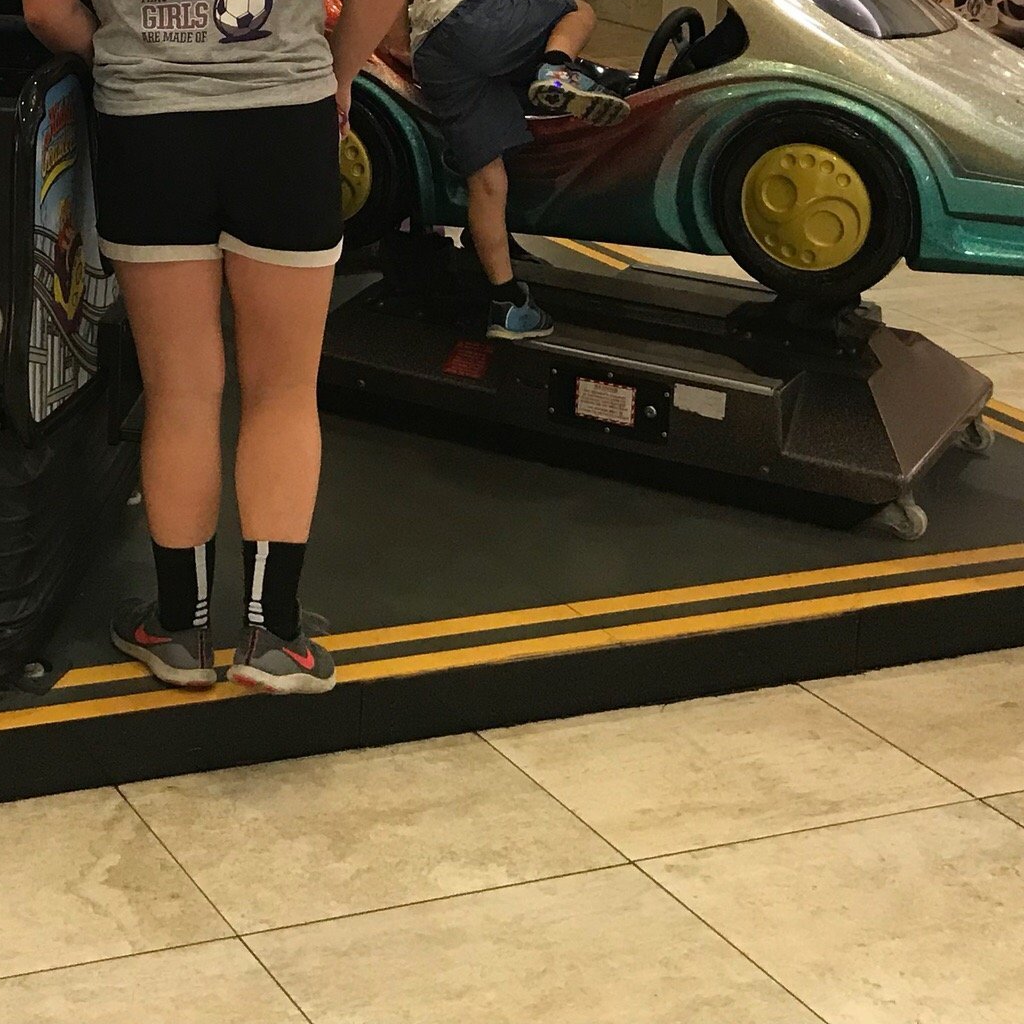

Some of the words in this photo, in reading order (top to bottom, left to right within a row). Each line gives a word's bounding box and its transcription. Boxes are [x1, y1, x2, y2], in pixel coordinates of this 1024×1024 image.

[141, 1, 210, 31] GIRLS
[142, 32, 160, 44] ARE
[163, 31, 194, 43] MADE
[195, 31, 207, 43] OF
